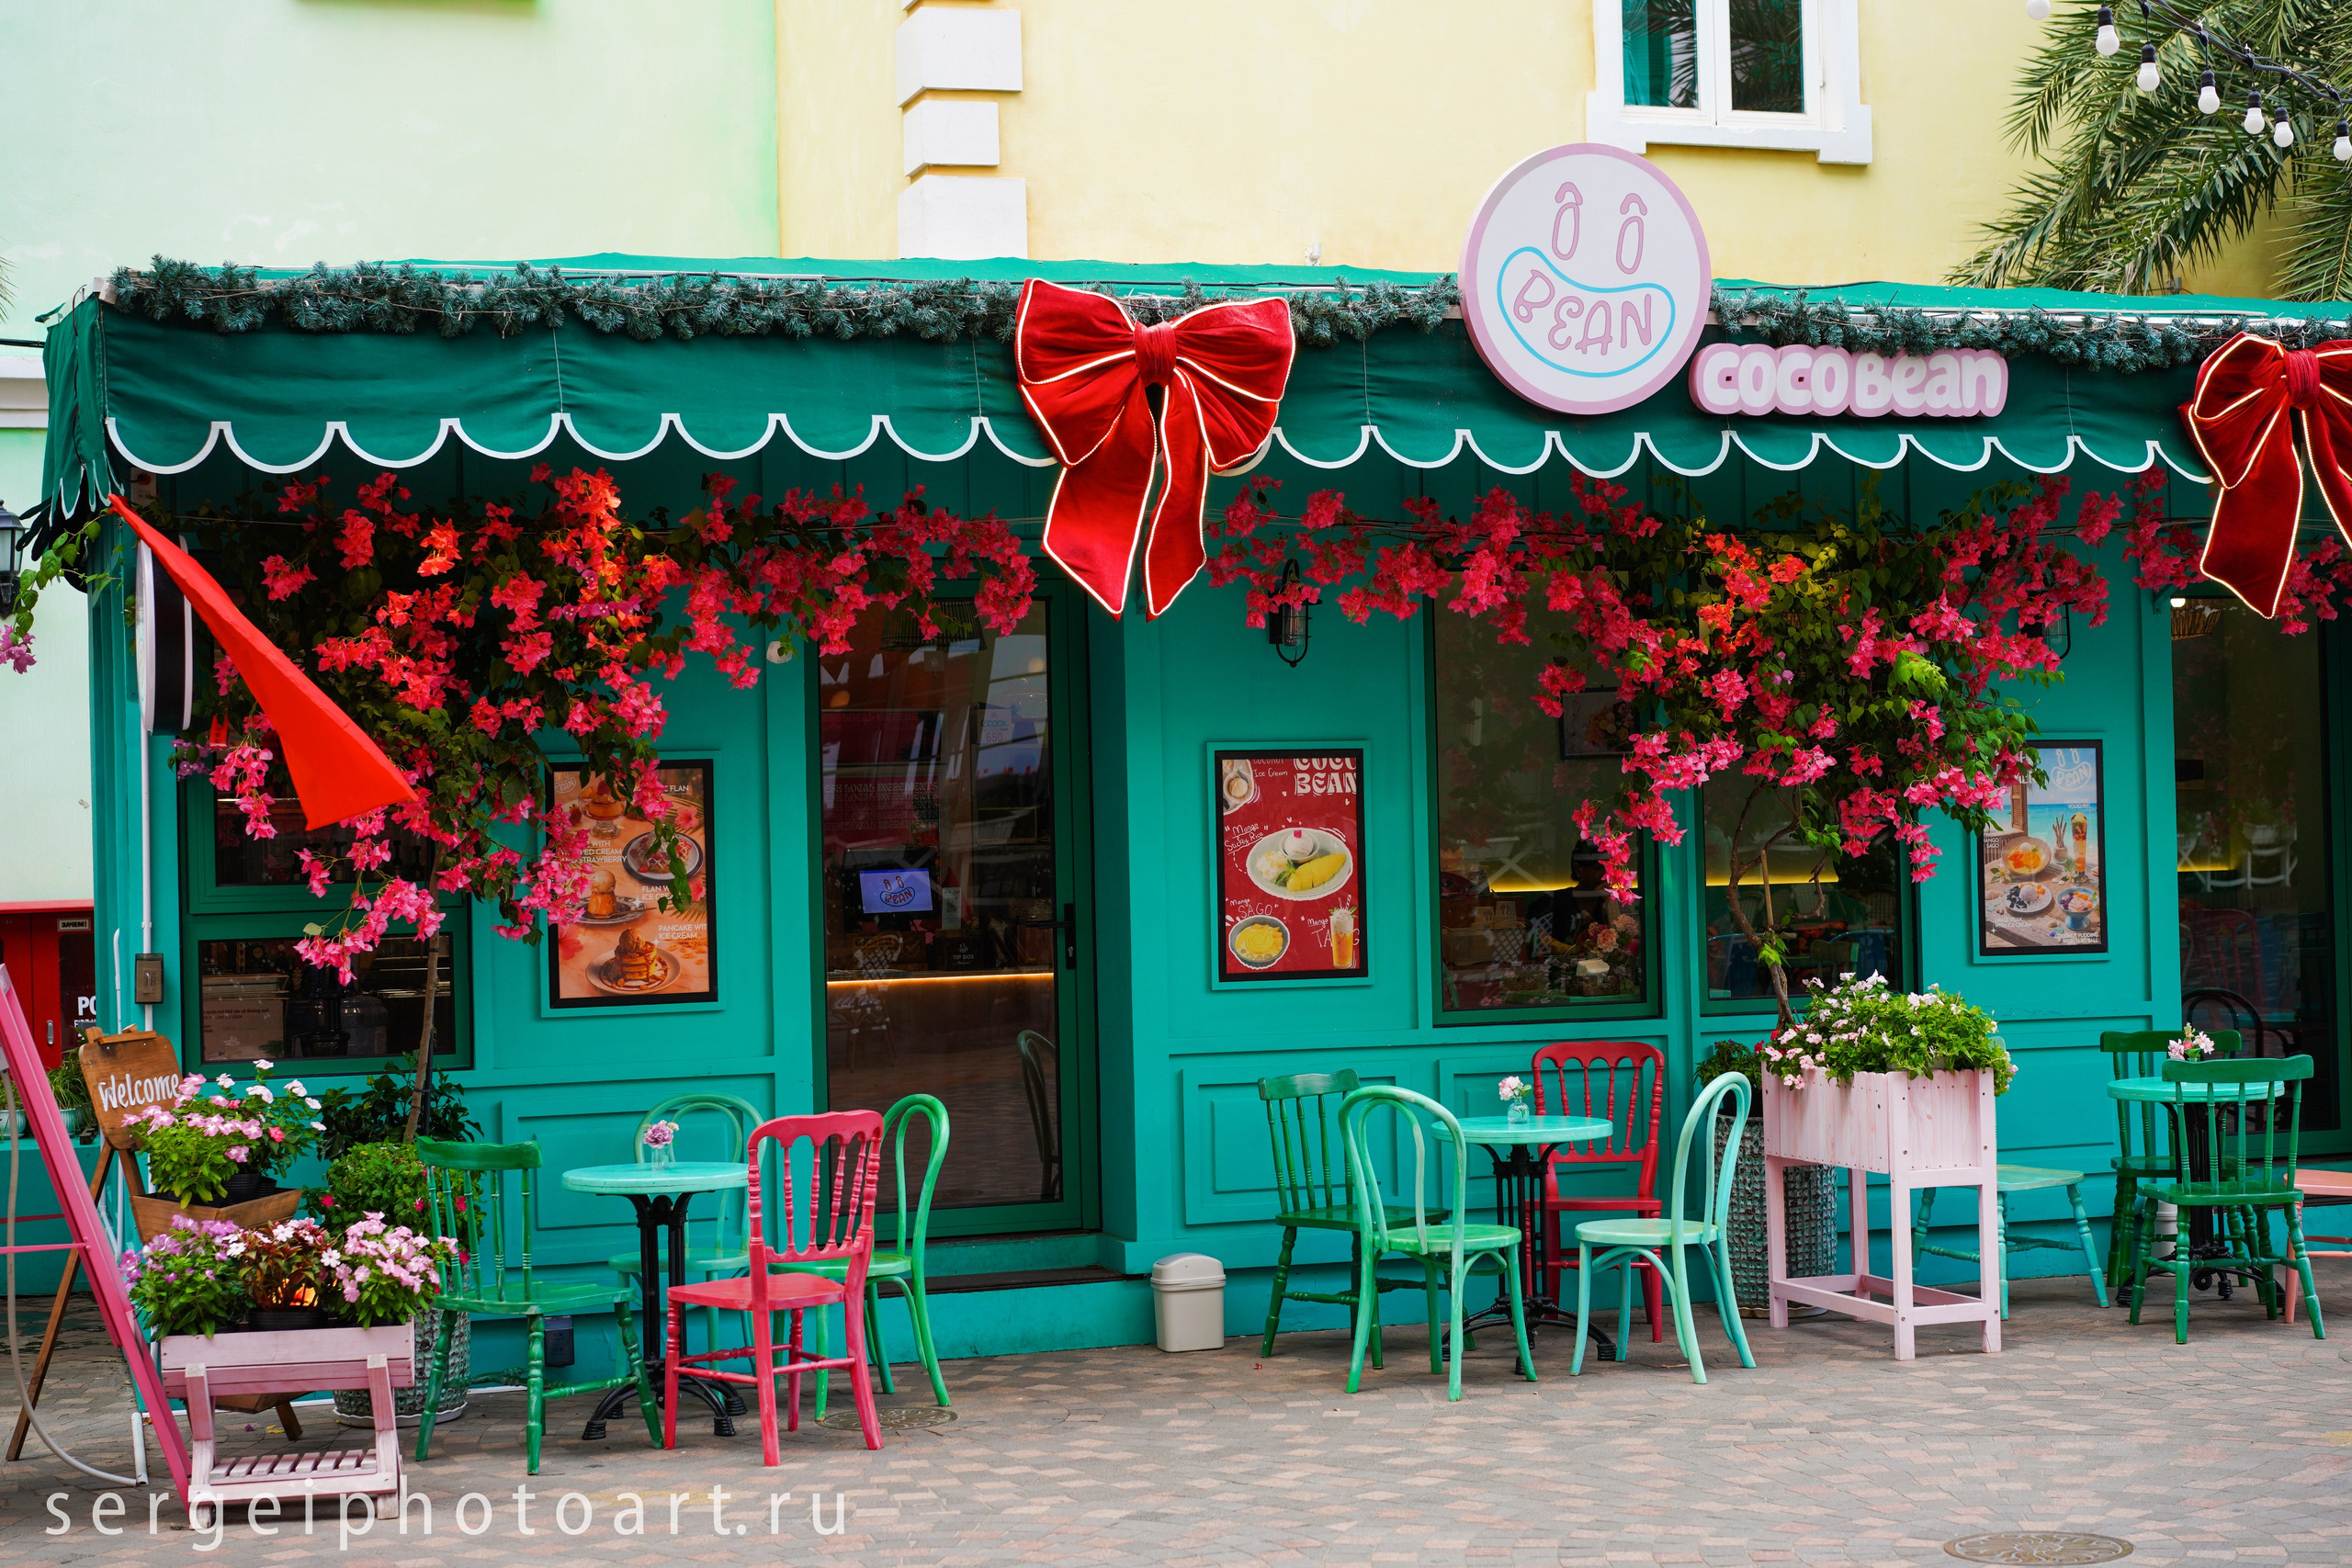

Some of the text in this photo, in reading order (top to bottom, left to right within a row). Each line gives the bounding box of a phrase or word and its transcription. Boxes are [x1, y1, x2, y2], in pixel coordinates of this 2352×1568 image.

[1512, 269, 1653, 355] BEAN
[986, 732, 1003, 742] 650
[1253, 768, 1288, 778] Ice Cream
[2056, 764, 2088, 787] BEAN
[1225, 832, 1264, 852] Sticky Rice
[884, 888, 913, 905] BEAN
[97, 1073, 180, 1112] Welcome
